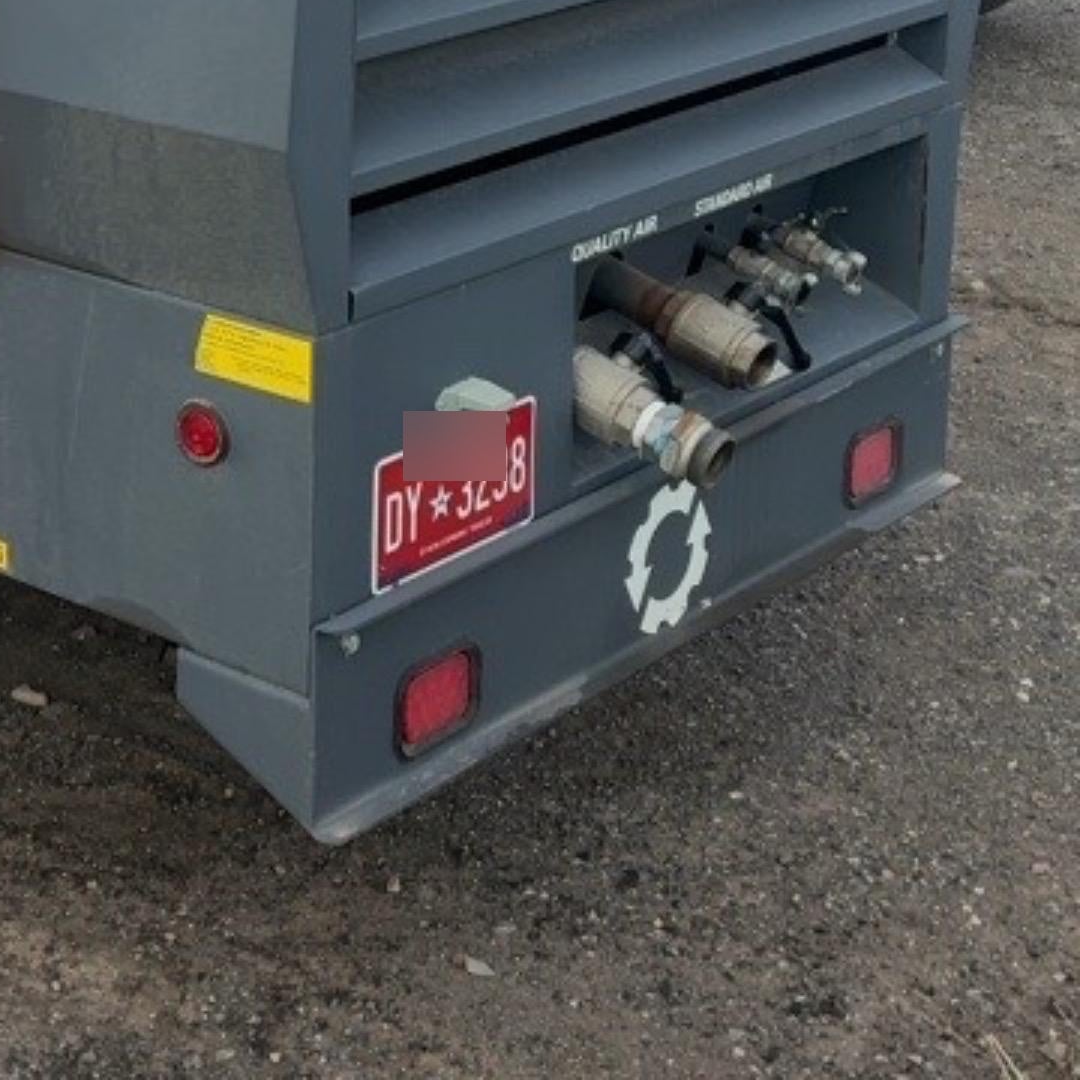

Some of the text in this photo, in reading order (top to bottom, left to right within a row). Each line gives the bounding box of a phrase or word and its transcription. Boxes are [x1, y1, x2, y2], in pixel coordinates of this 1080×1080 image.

[572, 214, 659, 262] QUALITY AIR
[385, 480, 423, 555] DY
